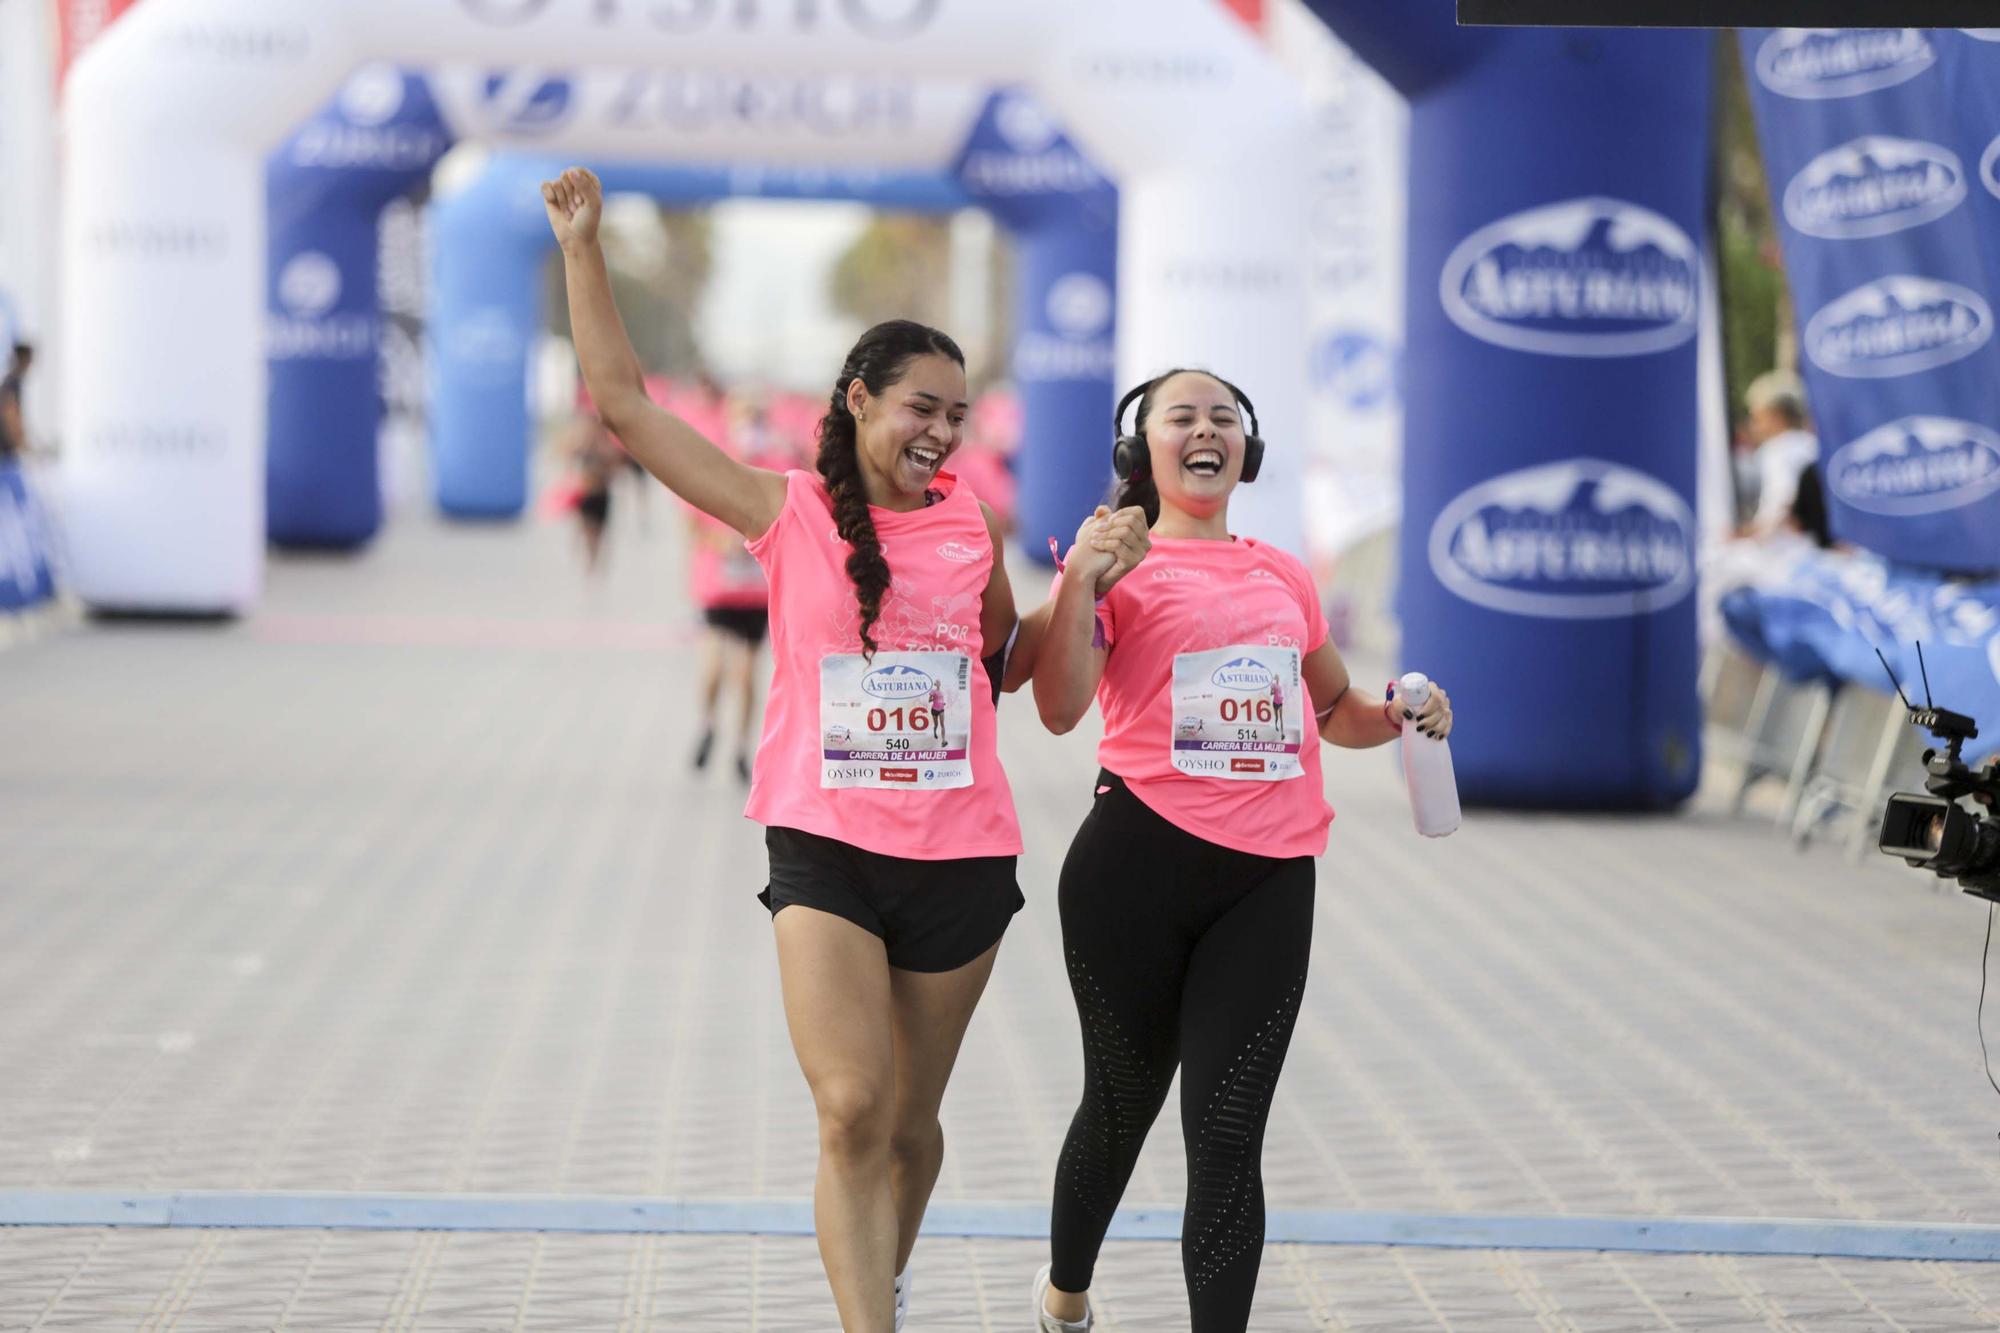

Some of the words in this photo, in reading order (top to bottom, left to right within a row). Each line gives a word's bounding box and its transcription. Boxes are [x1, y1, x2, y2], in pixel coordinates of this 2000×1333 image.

[936, 623, 969, 640] POR
[1218, 672, 1270, 684] ASTURIANA
[867, 678, 928, 692] ASTURIANA
[1220, 698, 1272, 723] 016
[866, 706, 929, 732] 016
[1237, 729, 1258, 740] 514
[885, 738, 910, 750] 540
[1201, 741, 1240, 751] CARRERA
[1242, 742, 1252, 751] DE
[1253, 742, 1264, 751] LA
[1264, 743, 1286, 753] MUJER
[849, 751, 888, 761] CARRERA
[890, 752, 902, 761] DE
[904, 752, 916, 761] LA
[918, 751, 948, 761] MUJER
[1178, 759, 1225, 770] OYSHO
[827, 767, 874, 780] OYSHO
